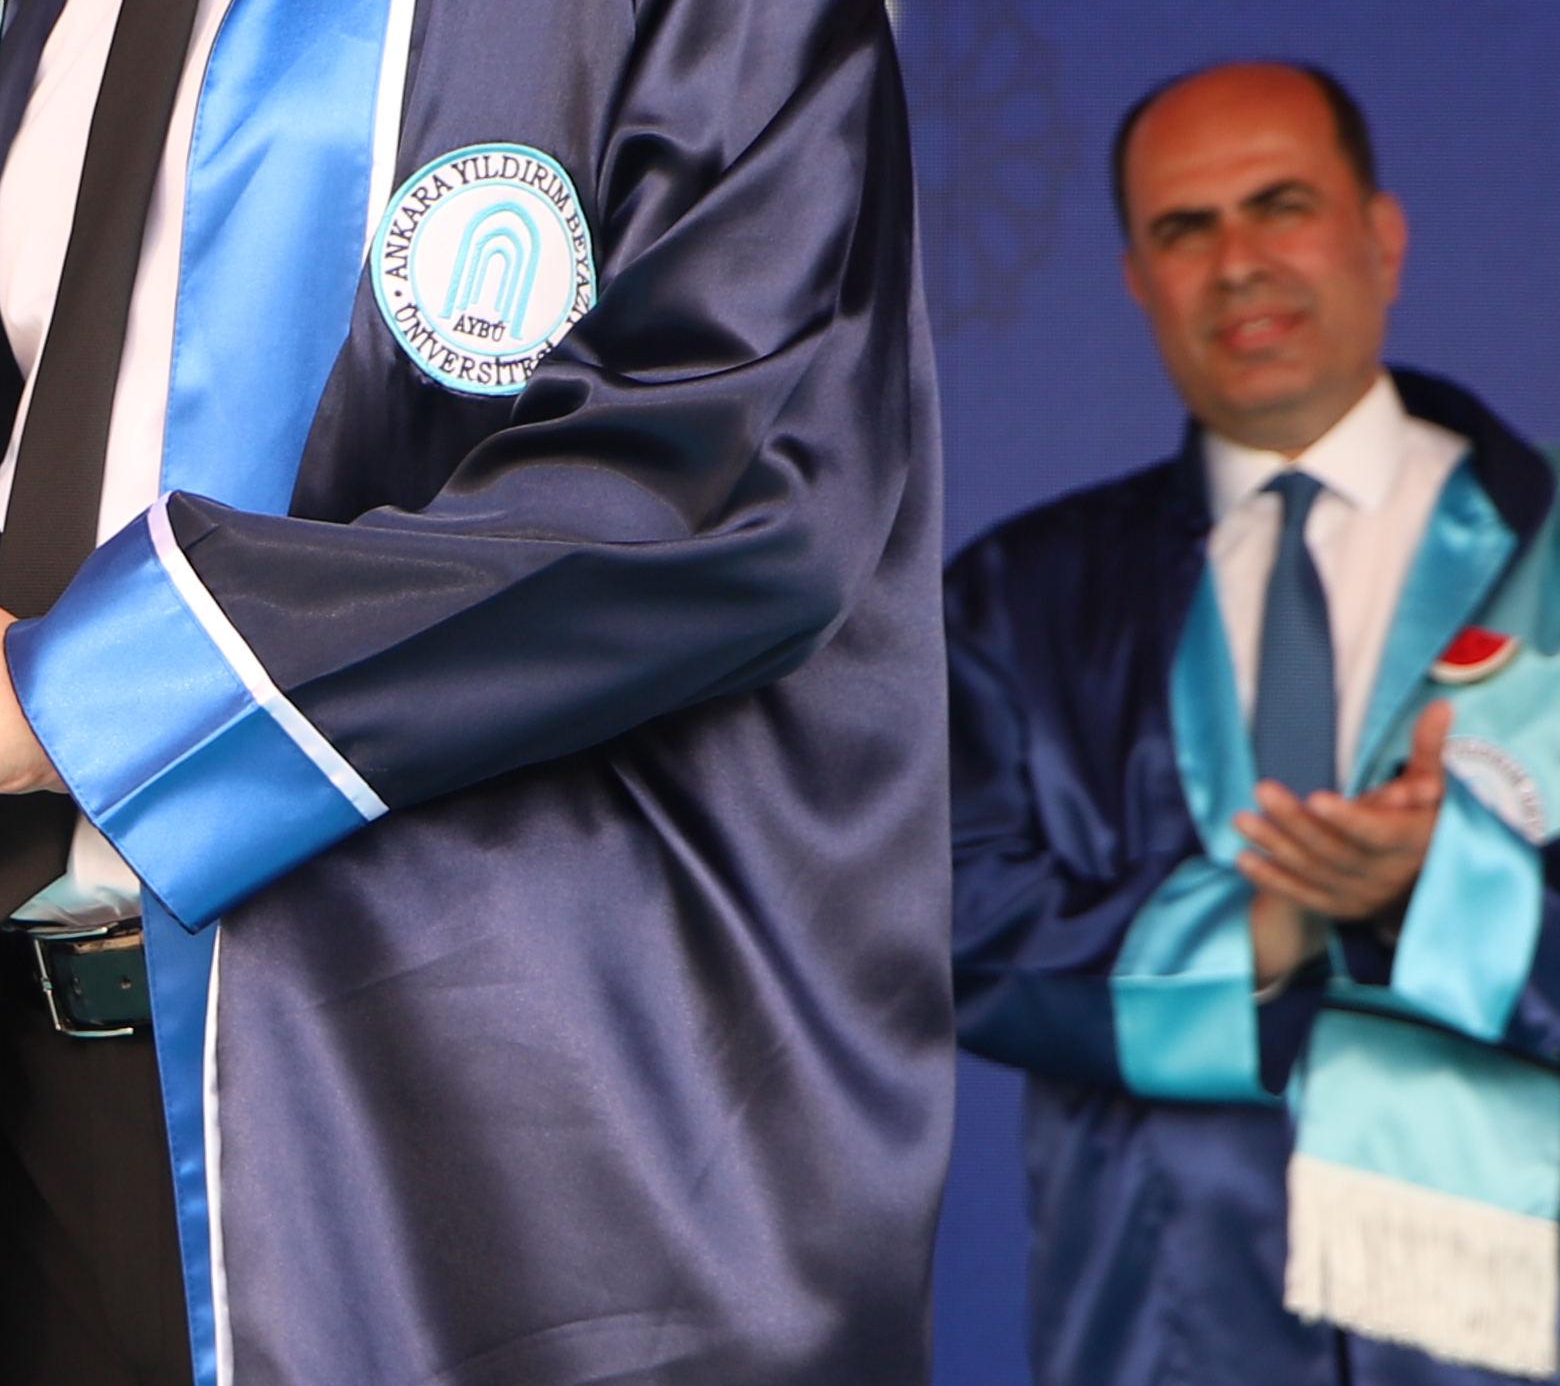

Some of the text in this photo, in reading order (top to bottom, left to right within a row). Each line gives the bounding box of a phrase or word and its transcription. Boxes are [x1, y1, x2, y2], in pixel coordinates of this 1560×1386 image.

[384, 173, 454, 282] ANKARA
[451, 154, 573, 213] YILDIRIM
[452, 313, 507, 343] AYBÜ
